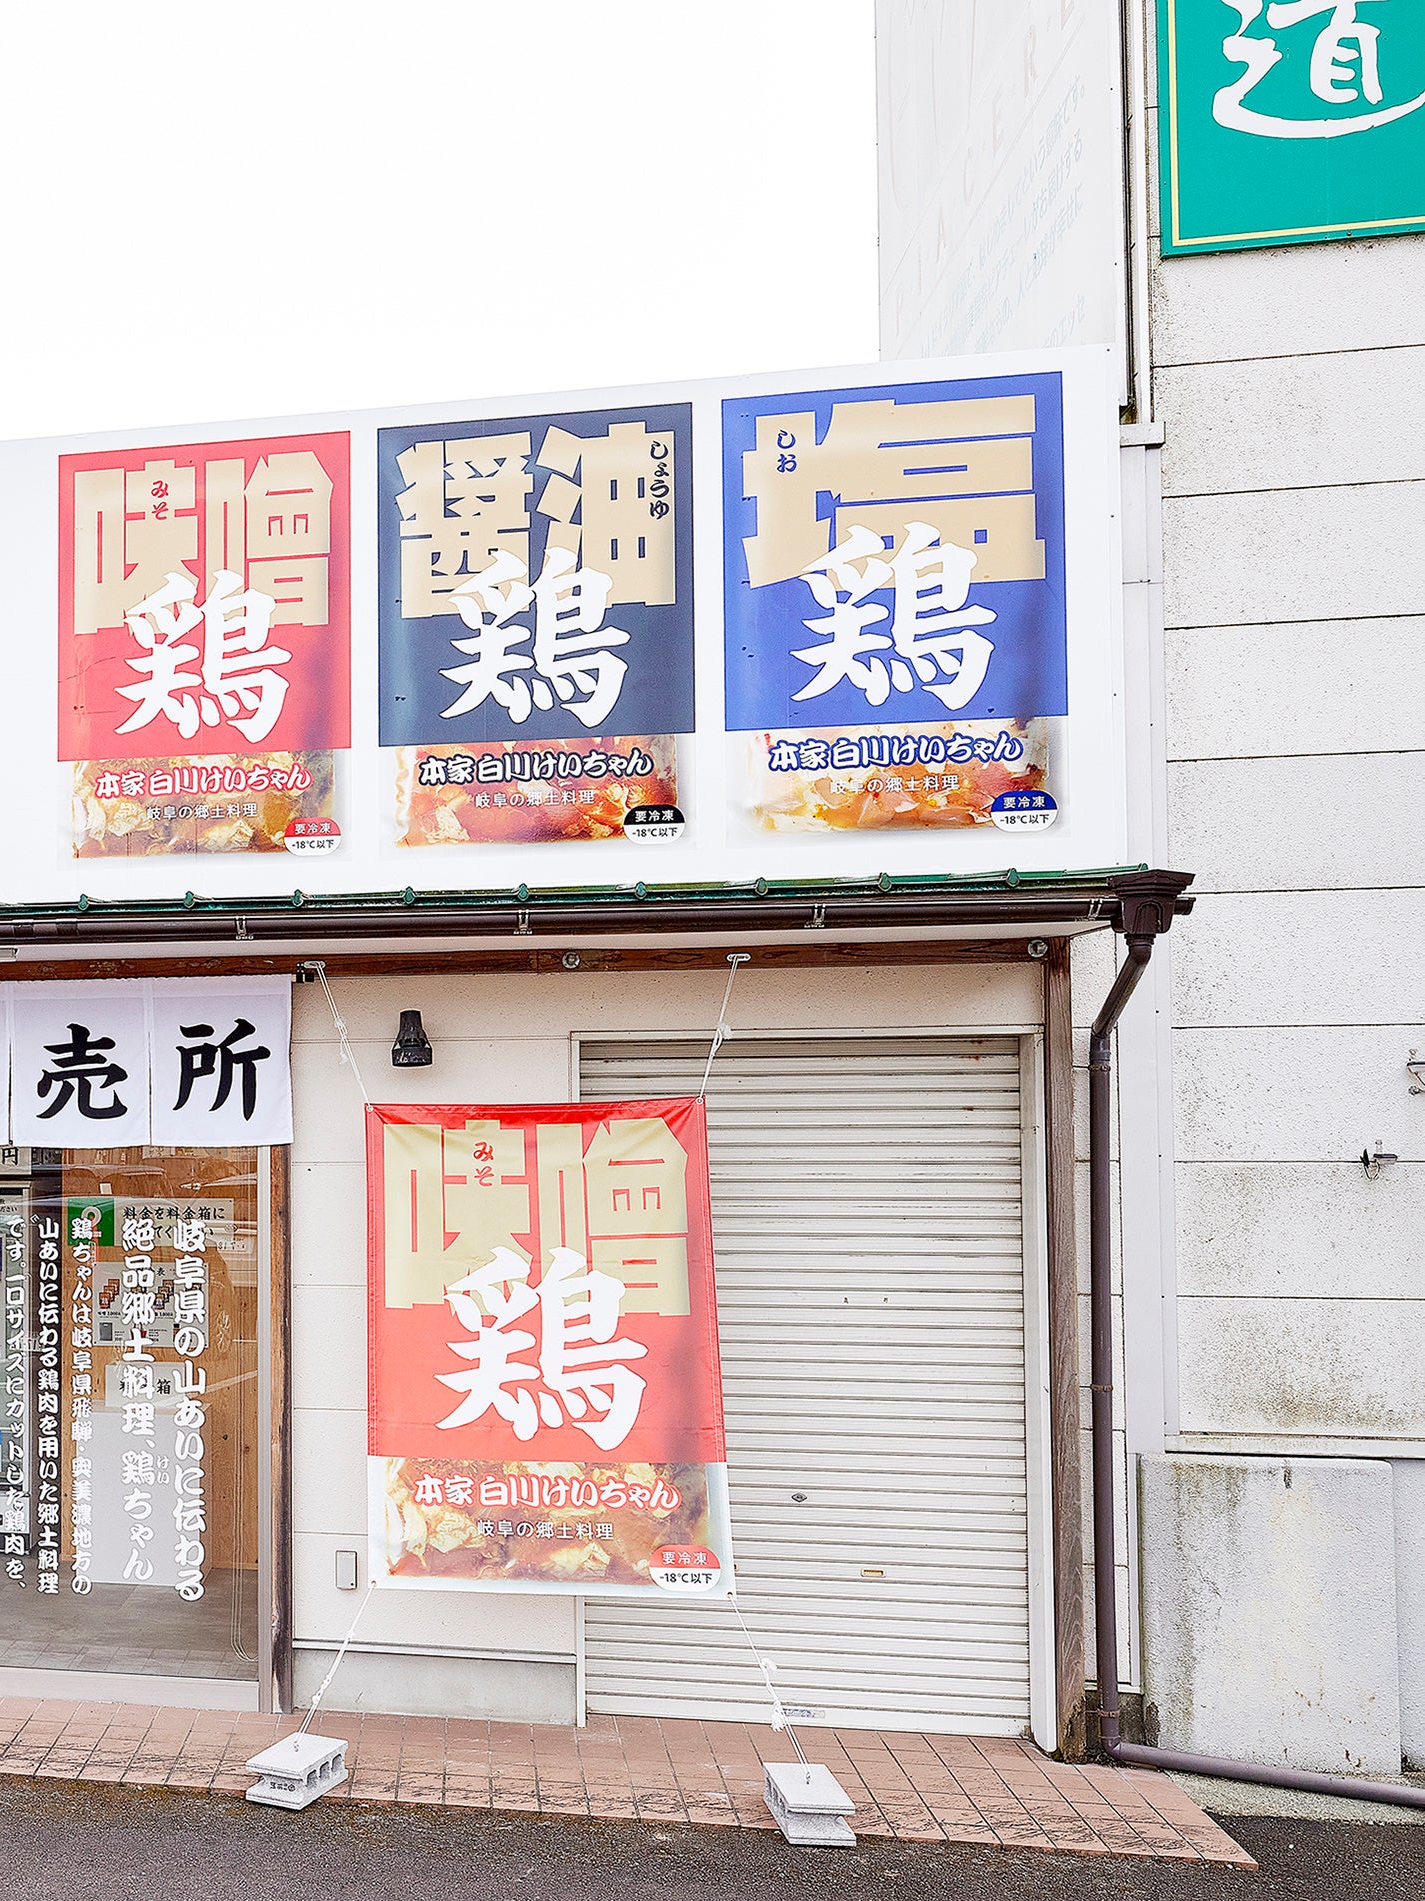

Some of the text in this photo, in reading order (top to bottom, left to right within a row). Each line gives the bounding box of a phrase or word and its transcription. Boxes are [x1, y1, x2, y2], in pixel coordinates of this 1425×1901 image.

[776, 429, 796, 473] しお
[151, 480, 169, 520] みそ
[650, 441, 671, 520] しょうゆ
[741, 394, 1046, 589] 塩
[395, 422, 675, 619] 醤油
[440, 547, 631, 728] 鶏
[791, 522, 997, 712] 鶏
[115, 569, 292, 744] 鶏
[475, 789, 595, 808] 岐阜の郷土料理
[830, 774, 960, 794] 岐阜の郷土料理
[1003, 796, 1046, 809] 要冷凍
[147, 803, 257, 820] 岐阜の郷土料理
[295, 822, 331, 835] 要冷凍
[635, 810, 674, 822] 要冷凍
[473, 1140, 496, 1188] みそ
[123, 1206, 225, 1221] 料金を料金箱に
[434, 1246, 649, 1453] 鶏
[37, 1217, 60, 1595] 山あいに伝わる鶏肉を用いた郷土料理
[121, 1217, 156, 1581] 絶品郷土料理、鶏ちゃん
[172, 1218, 207, 1602] 岐阜県の山あいに伝わる
[156, 1455, 170, 1485] けい
[476, 1520, 615, 1541] 岐阜の郷土料理
[661, 1551, 709, 1566] 要冷凍
